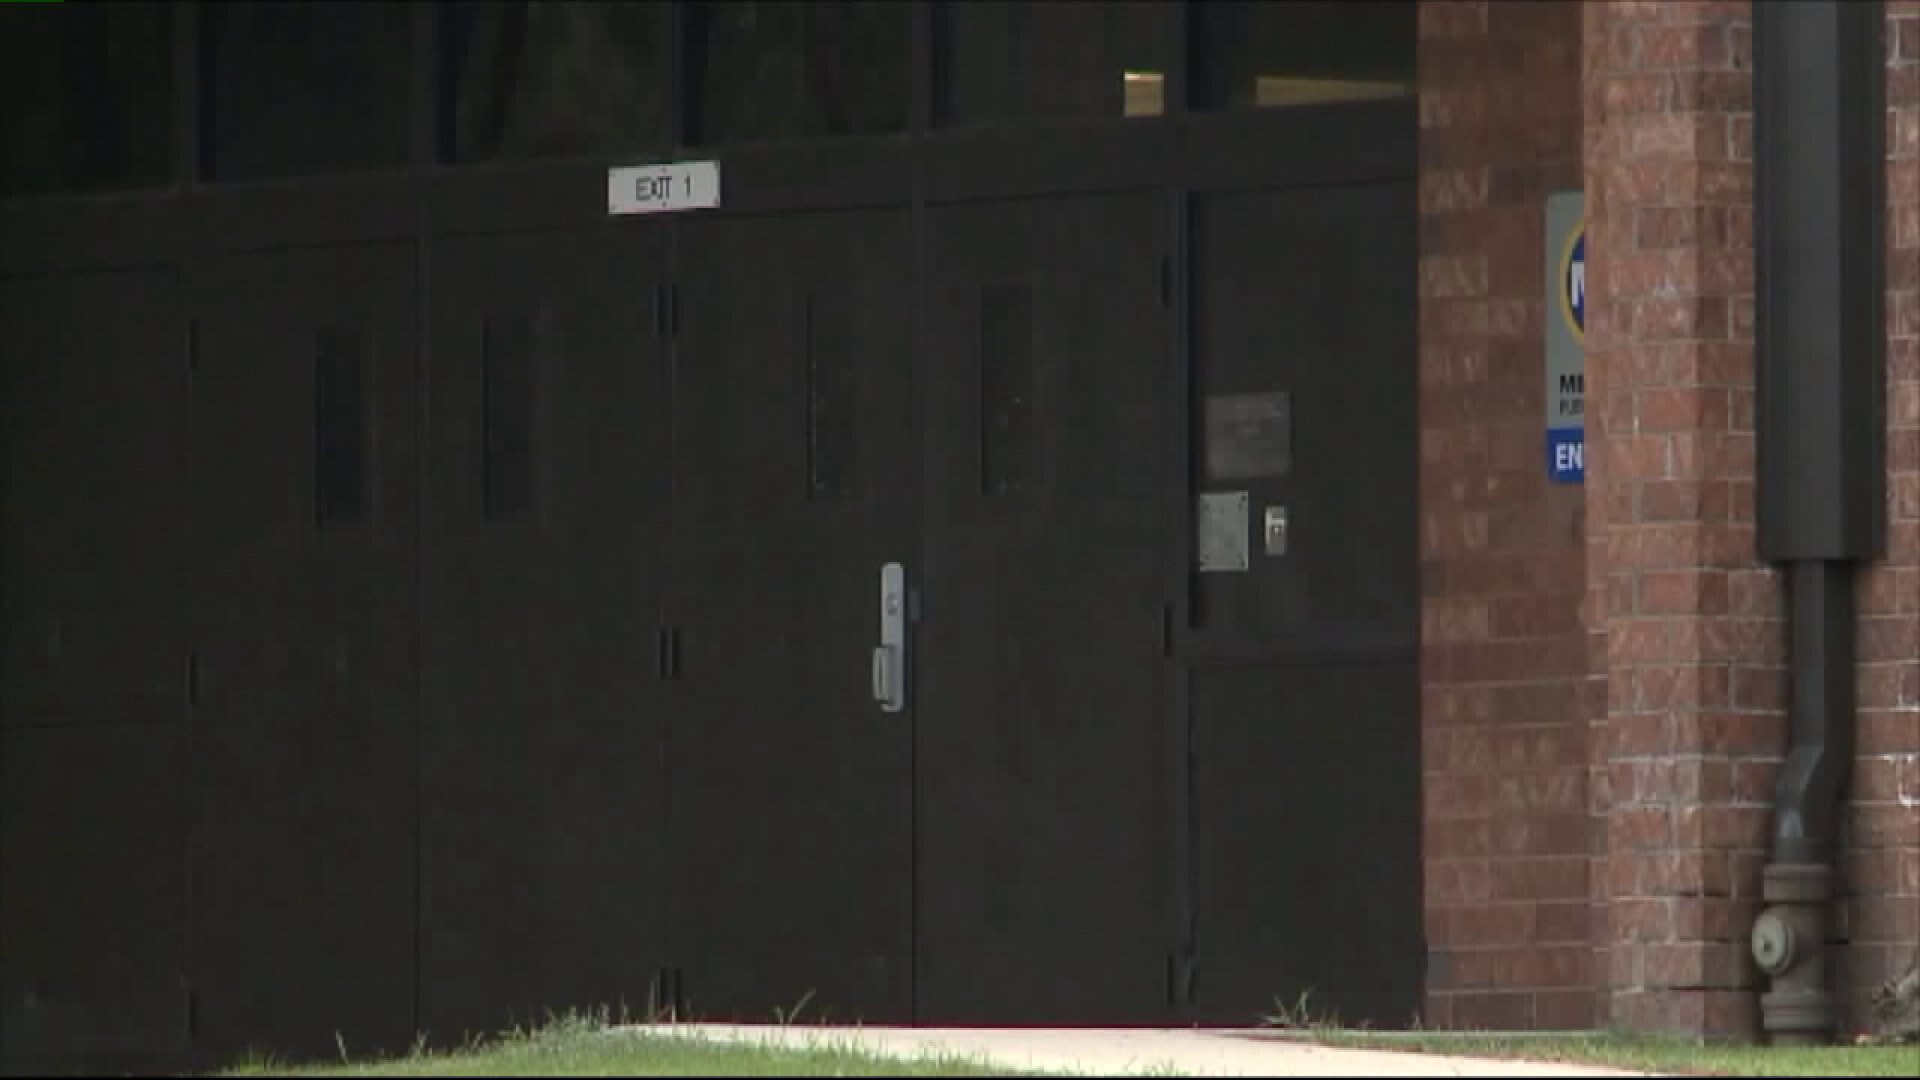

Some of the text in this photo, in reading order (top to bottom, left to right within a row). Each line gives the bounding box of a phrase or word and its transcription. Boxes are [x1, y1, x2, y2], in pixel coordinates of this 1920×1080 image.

[635, 172, 691, 201] EXIT 1
[1556, 442, 1583, 471] EN
